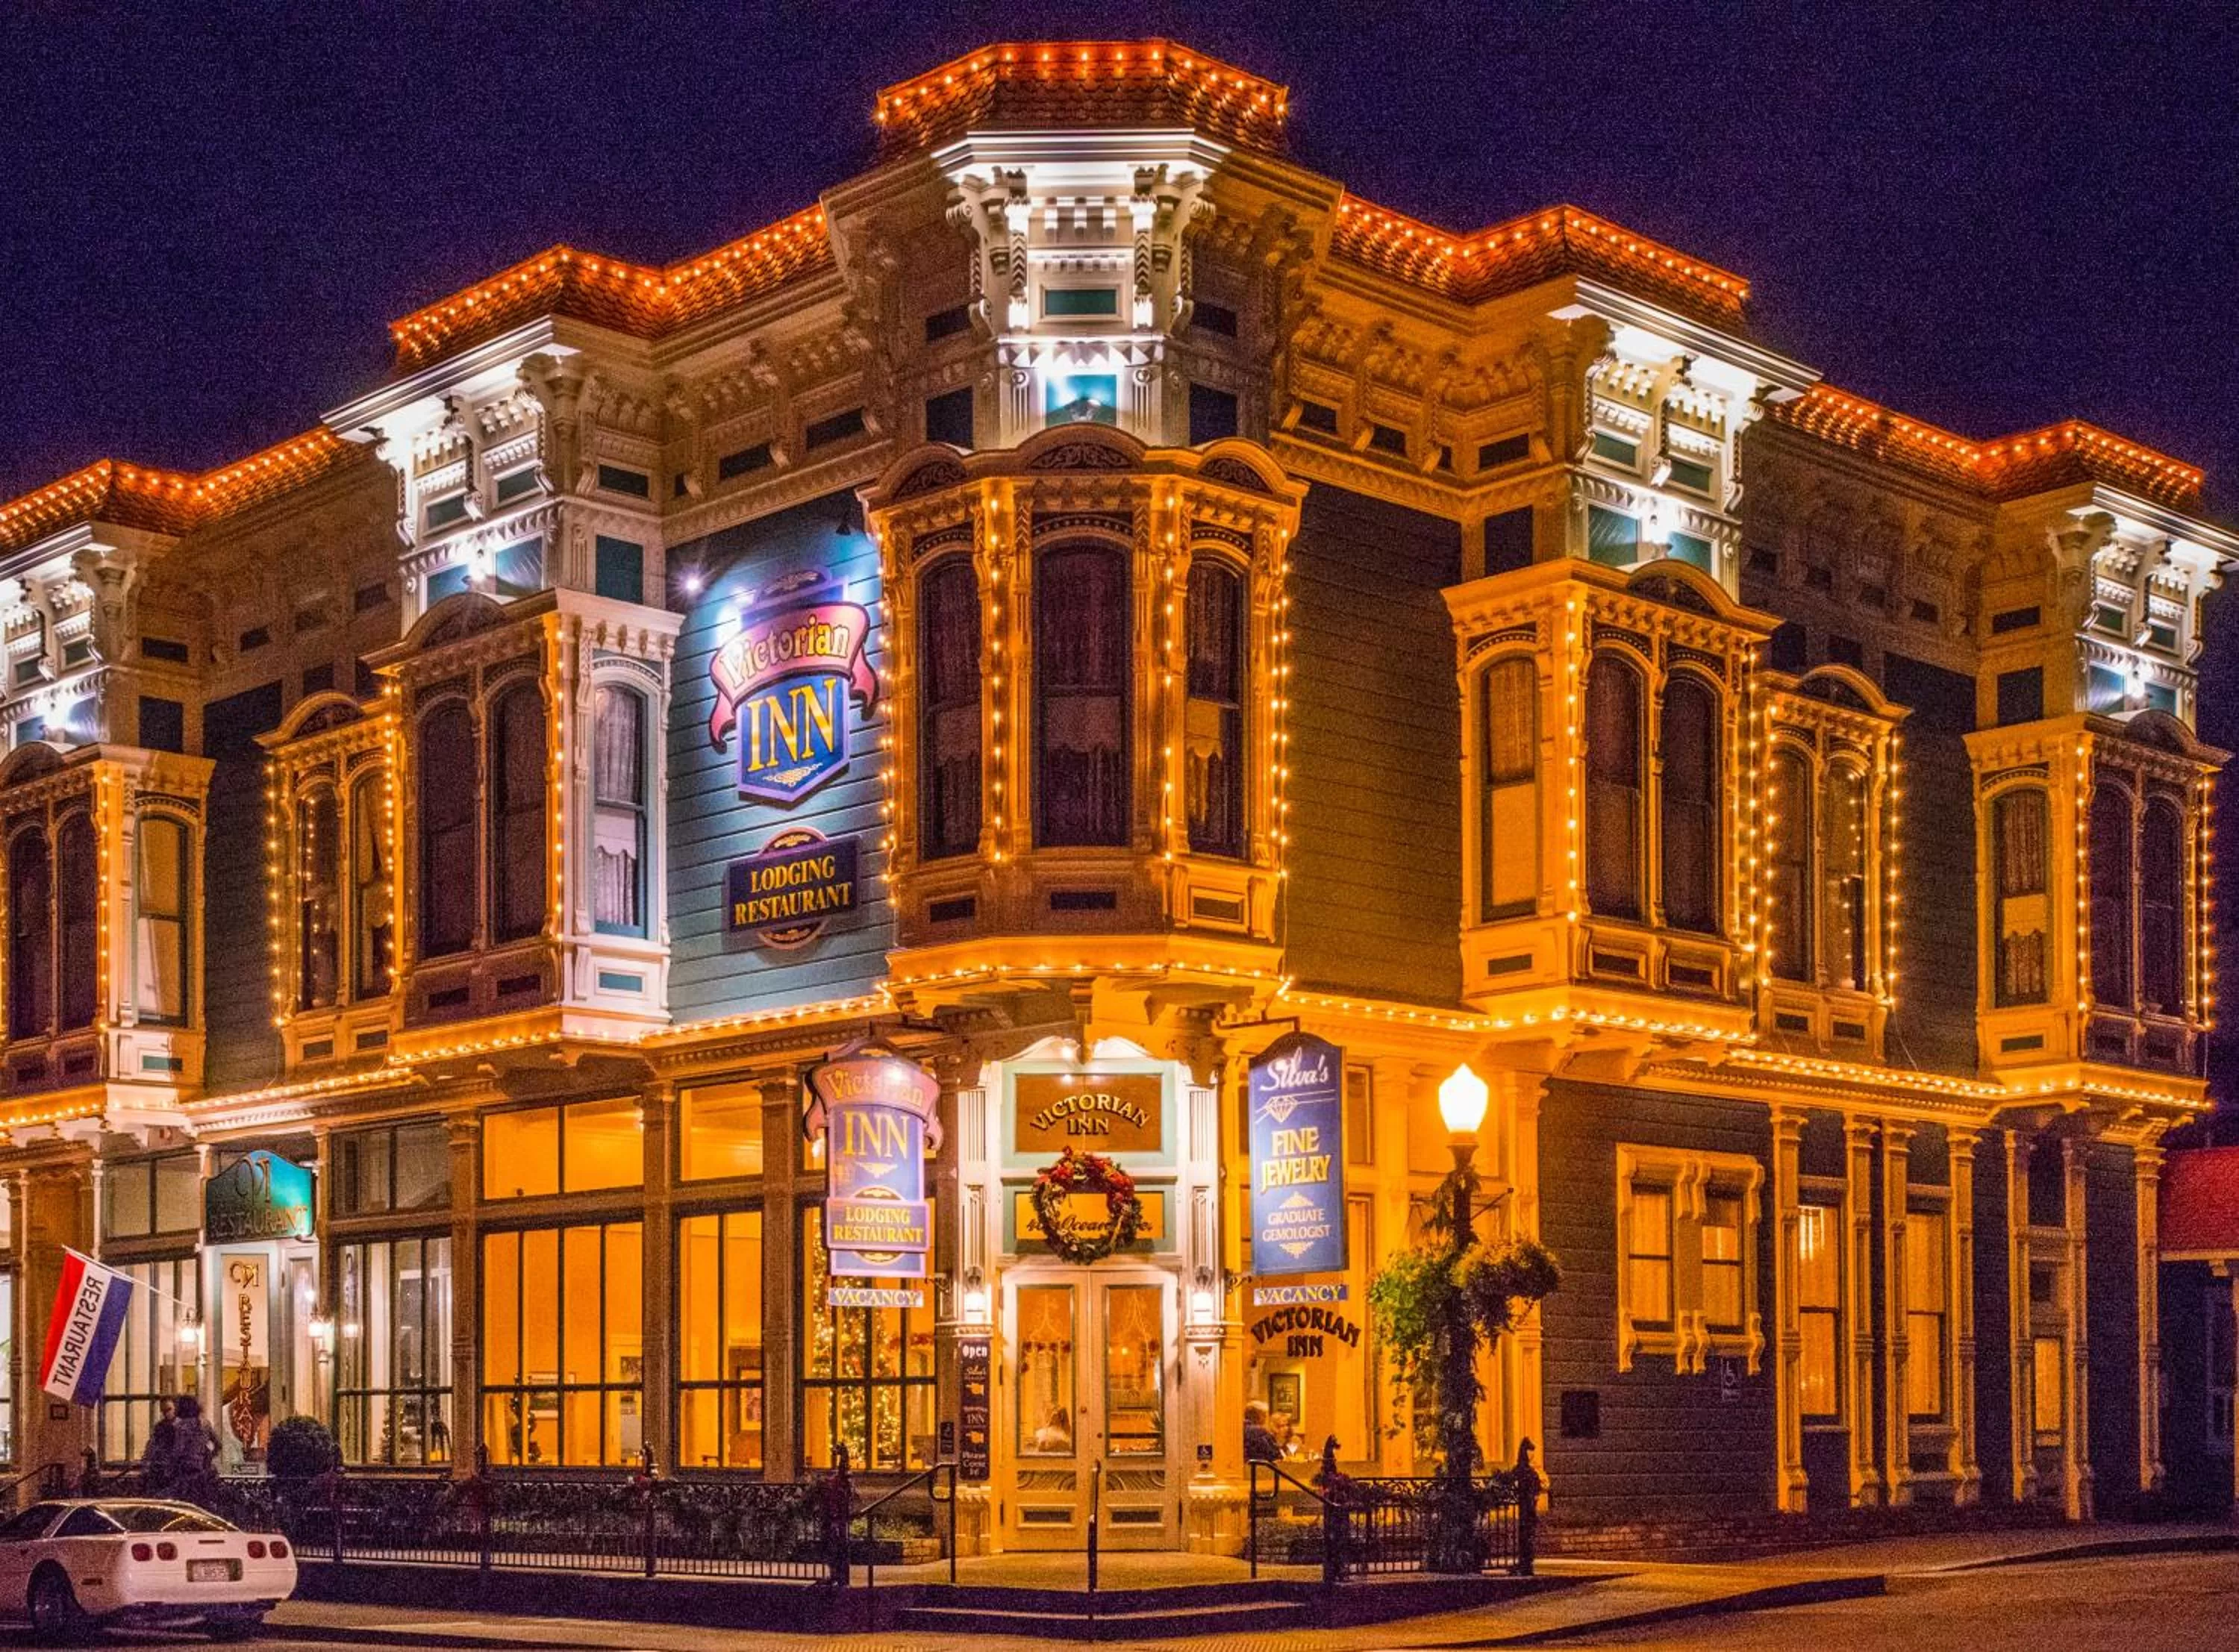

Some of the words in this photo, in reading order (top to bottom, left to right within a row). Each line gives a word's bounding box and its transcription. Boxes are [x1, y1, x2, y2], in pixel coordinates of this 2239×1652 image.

[719, 614, 849, 689] Victorian
[747, 678, 837, 772] INN
[751, 855, 835, 893] LODGING
[734, 881, 852, 925] RESTAURANT
[1259, 1046, 1328, 1091] Silva's
[825, 1069, 923, 1107] Victan
[1029, 1093, 1151, 1130] VICTORIAN
[1067, 1118, 1110, 1134] INN
[843, 1110, 910, 1159] INN
[1271, 1127, 1320, 1157] FINE
[1261, 1154, 1331, 1194] JEWELRY
[210, 1205, 307, 1238] RESTAURANT
[833, 1224, 923, 1242] RESTAURANT
[846, 1207, 911, 1224] LODGING
[1262, 1224, 1332, 1242] GEMOLOGIST
[1268, 1209, 1325, 1225] GRADUATE
[834, 1289, 918, 1306] VACANCY
[1260, 1284, 1342, 1304] VACANCY
[1251, 1306, 1361, 1348] VICTORIAN
[962, 1345, 987, 1359] Open
[1287, 1335, 1323, 1357] INN
[237, 1292, 253, 1449] RESTAURANT
